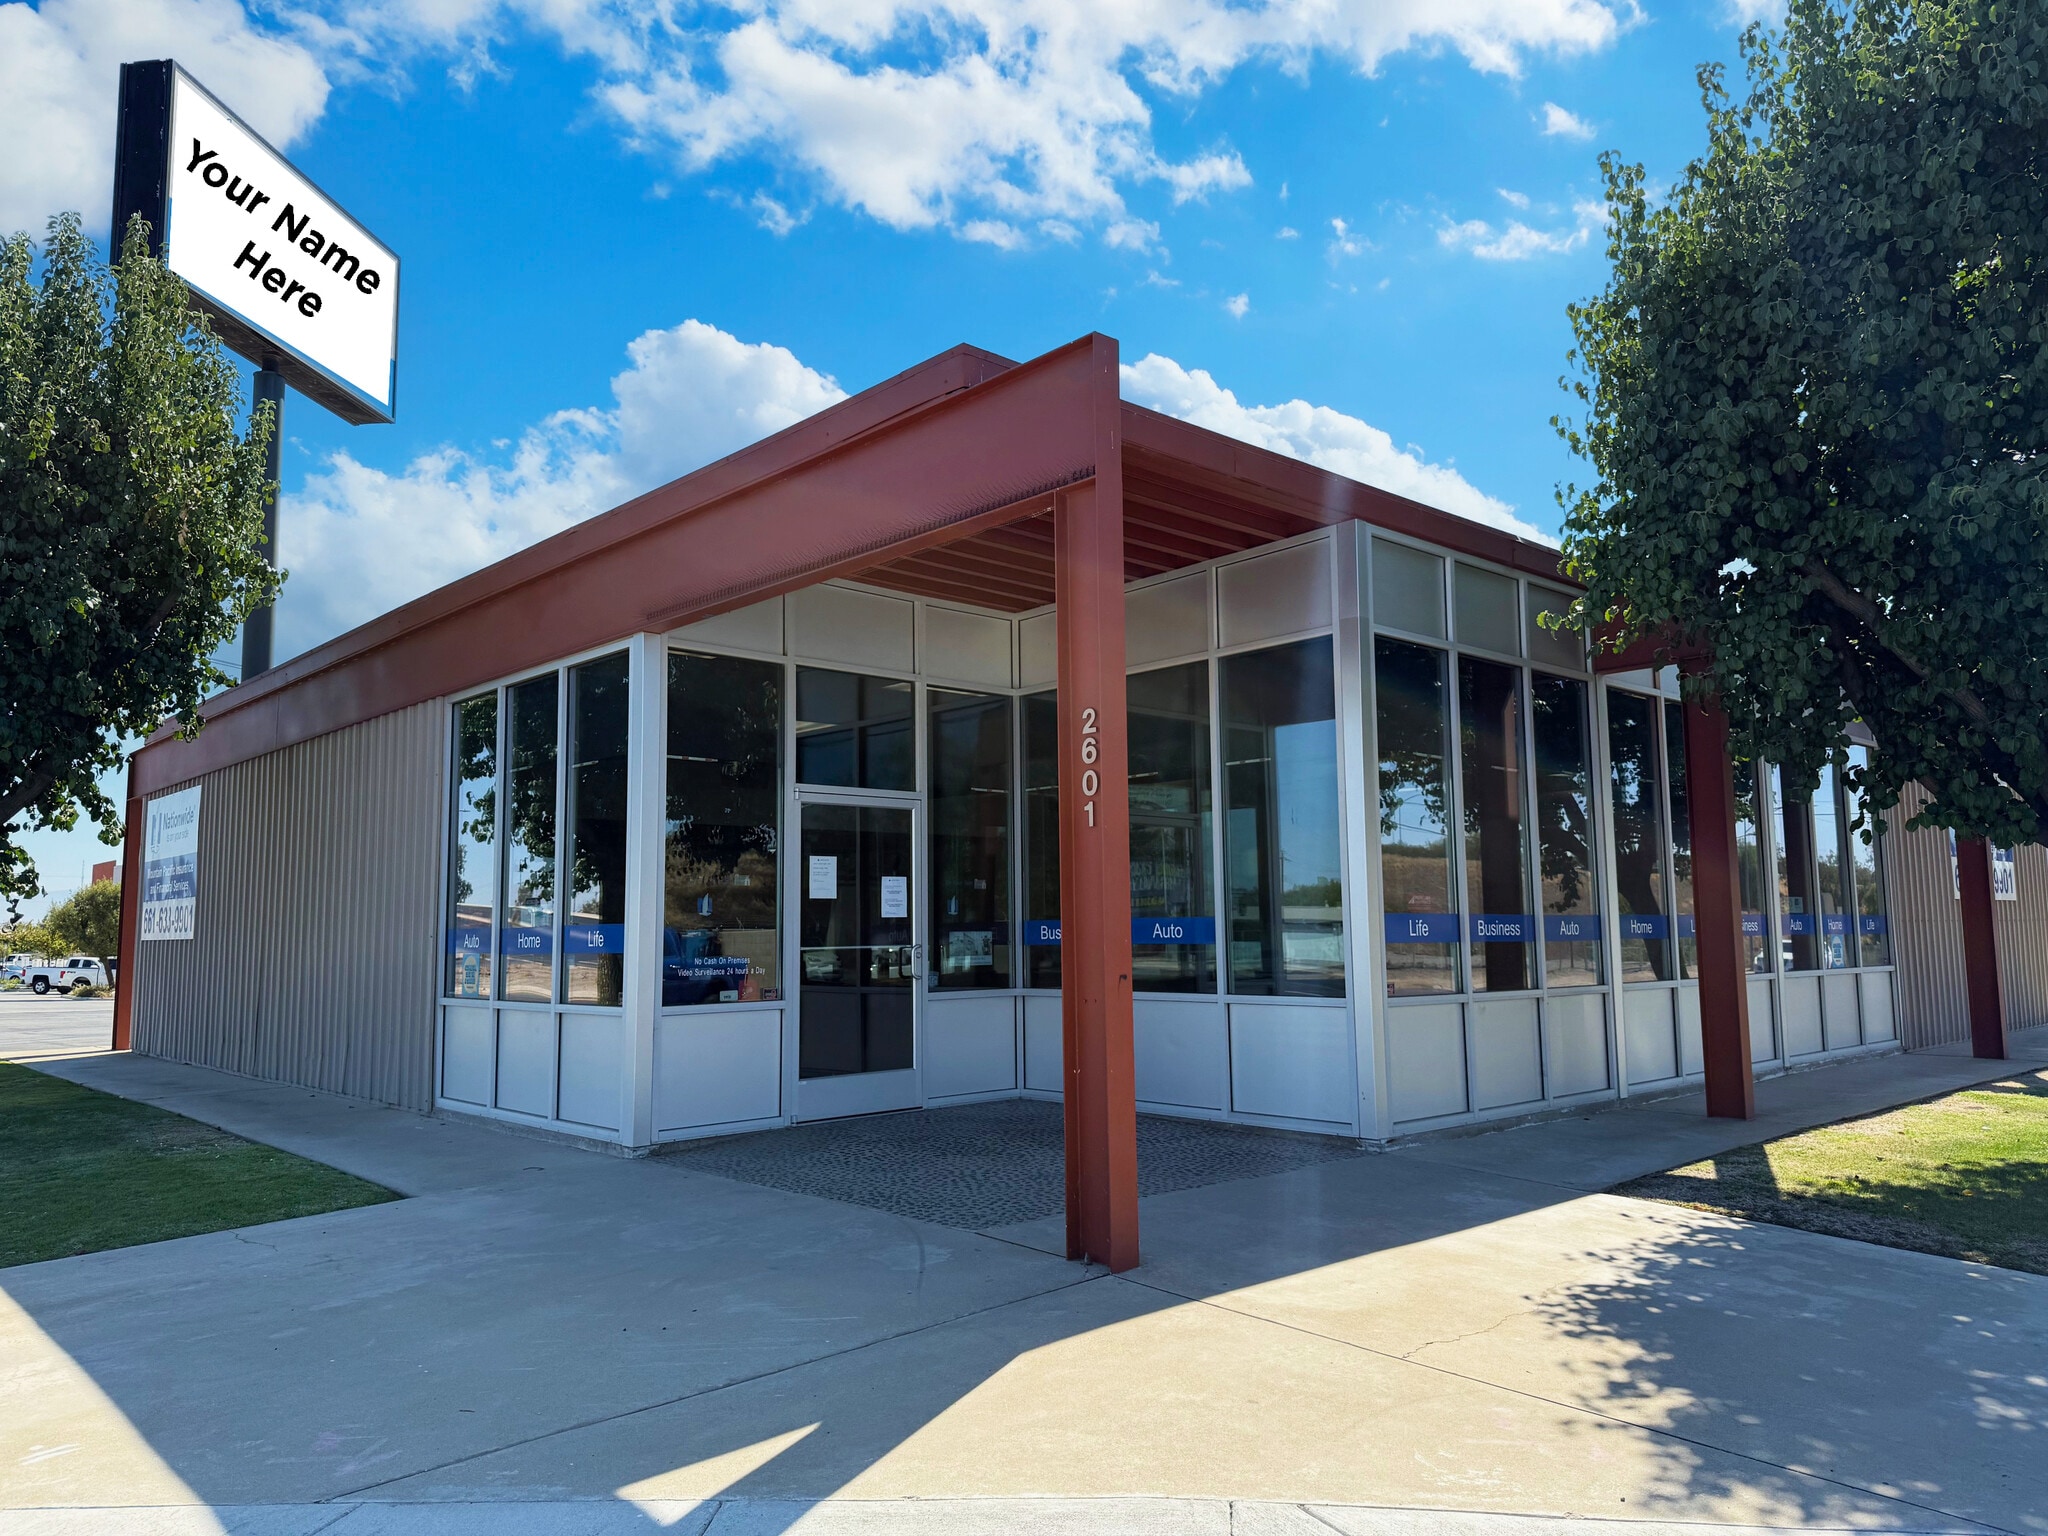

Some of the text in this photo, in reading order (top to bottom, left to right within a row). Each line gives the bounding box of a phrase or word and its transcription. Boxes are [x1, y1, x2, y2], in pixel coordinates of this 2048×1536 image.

[186, 137, 380, 295] Your Name
[232, 240, 323, 318] Here
[1081, 707, 1098, 827] 2601
[163, 806, 194, 831] Nationwide
[174, 880, 189, 892] Services
[143, 904, 194, 934] 661-633-9901
[1630, 920, 1652, 934] Home
[1790, 918, 1802, 930] Auto
[1828, 919, 1842, 930] Home
[1866, 919, 1875, 930] Life
[1152, 922, 1183, 938] Auto
[1409, 920, 1429, 936] Life
[1478, 920, 1520, 936] Business
[1560, 920, 1580, 936] Auto
[464, 933, 480, 949] Auto
[518, 933, 541, 948] Home
[587, 930, 604, 947] Life
[704, 957, 718, 965] Cash
[728, 956, 750, 964] Premises
[678, 968, 692, 977] Video
[726, 967, 734, 976] 24
[735, 966, 748, 975] hours
[756, 966, 766, 976] Day
